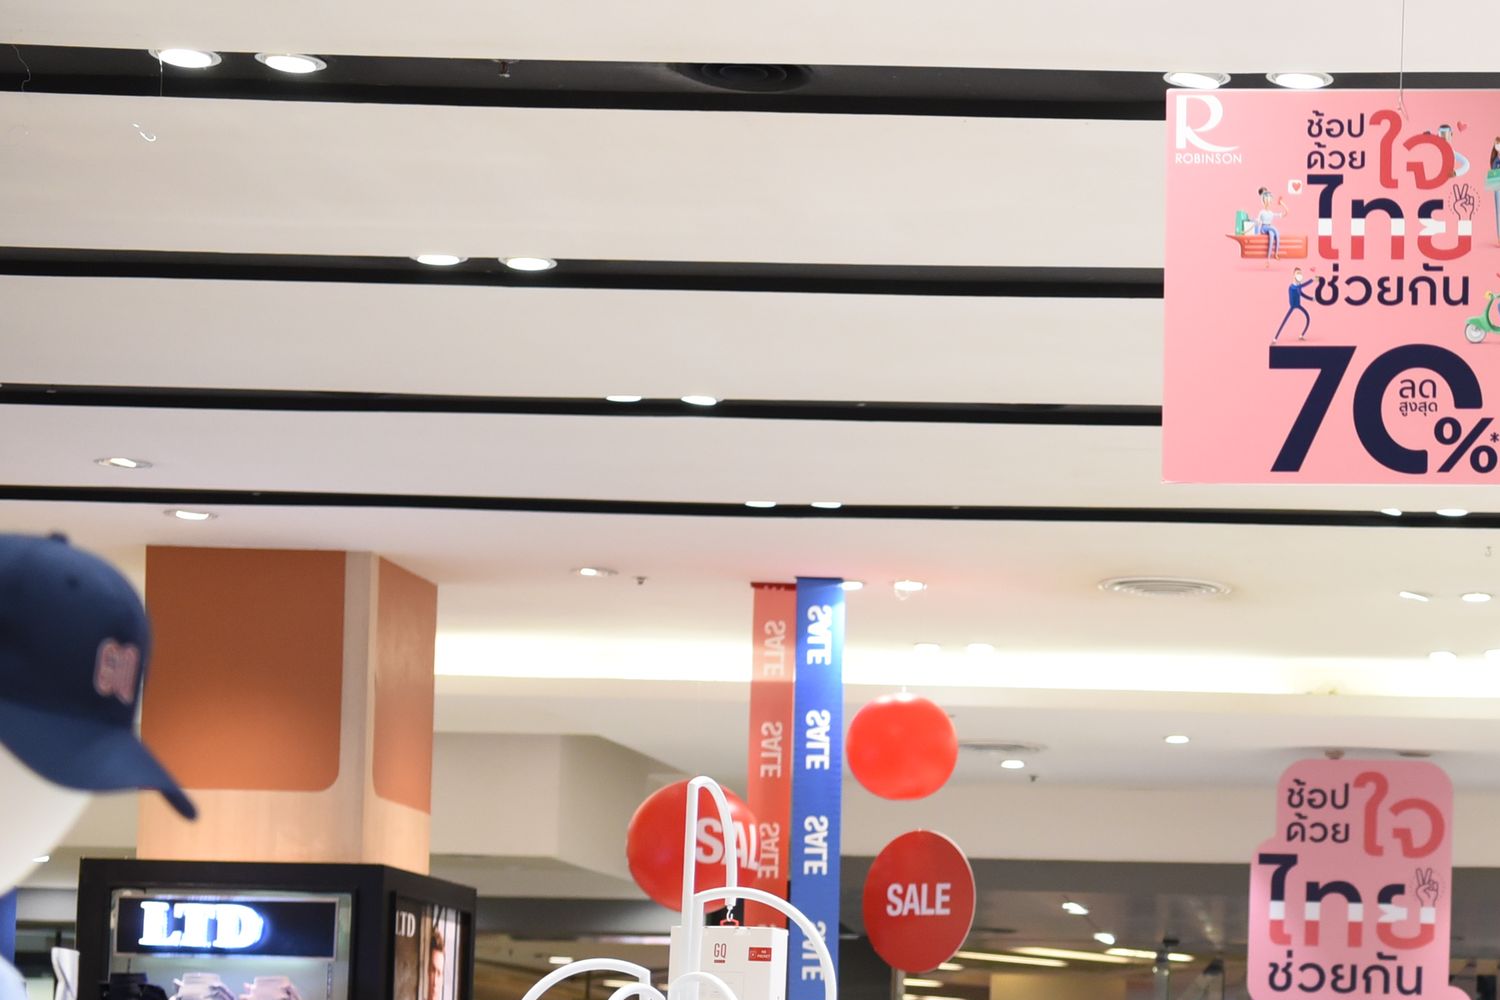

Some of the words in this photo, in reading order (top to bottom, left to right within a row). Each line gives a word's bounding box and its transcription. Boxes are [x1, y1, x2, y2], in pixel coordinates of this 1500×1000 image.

[1307, 111, 1365, 139] ช้อป
[1175, 153, 1242, 164] ROBINSON
[1307, 142, 1366, 170] ด้วย
[1369, 109, 1455, 190] ใจ
[1307, 174, 1473, 261] ไทย
[1315, 262, 1470, 306] ช่วยกัน
[1399, 377, 1437, 400] ลด
[1399, 400, 1438, 417] สูงสุด
[1287, 779, 1350, 810] ช้อป
[1287, 812, 1350, 843] ด้วย
[1353, 771, 1446, 858] ใจ
[696, 817, 761, 871] SAL
[886, 883, 951, 916] SALE
[1258, 853, 1437, 950] ไทย
[138, 900, 264, 949] LTD
[395, 910, 416, 938] LTD
[714, 943, 727, 959] GQ
[1268, 950, 1423, 996] ช่วยกัน
